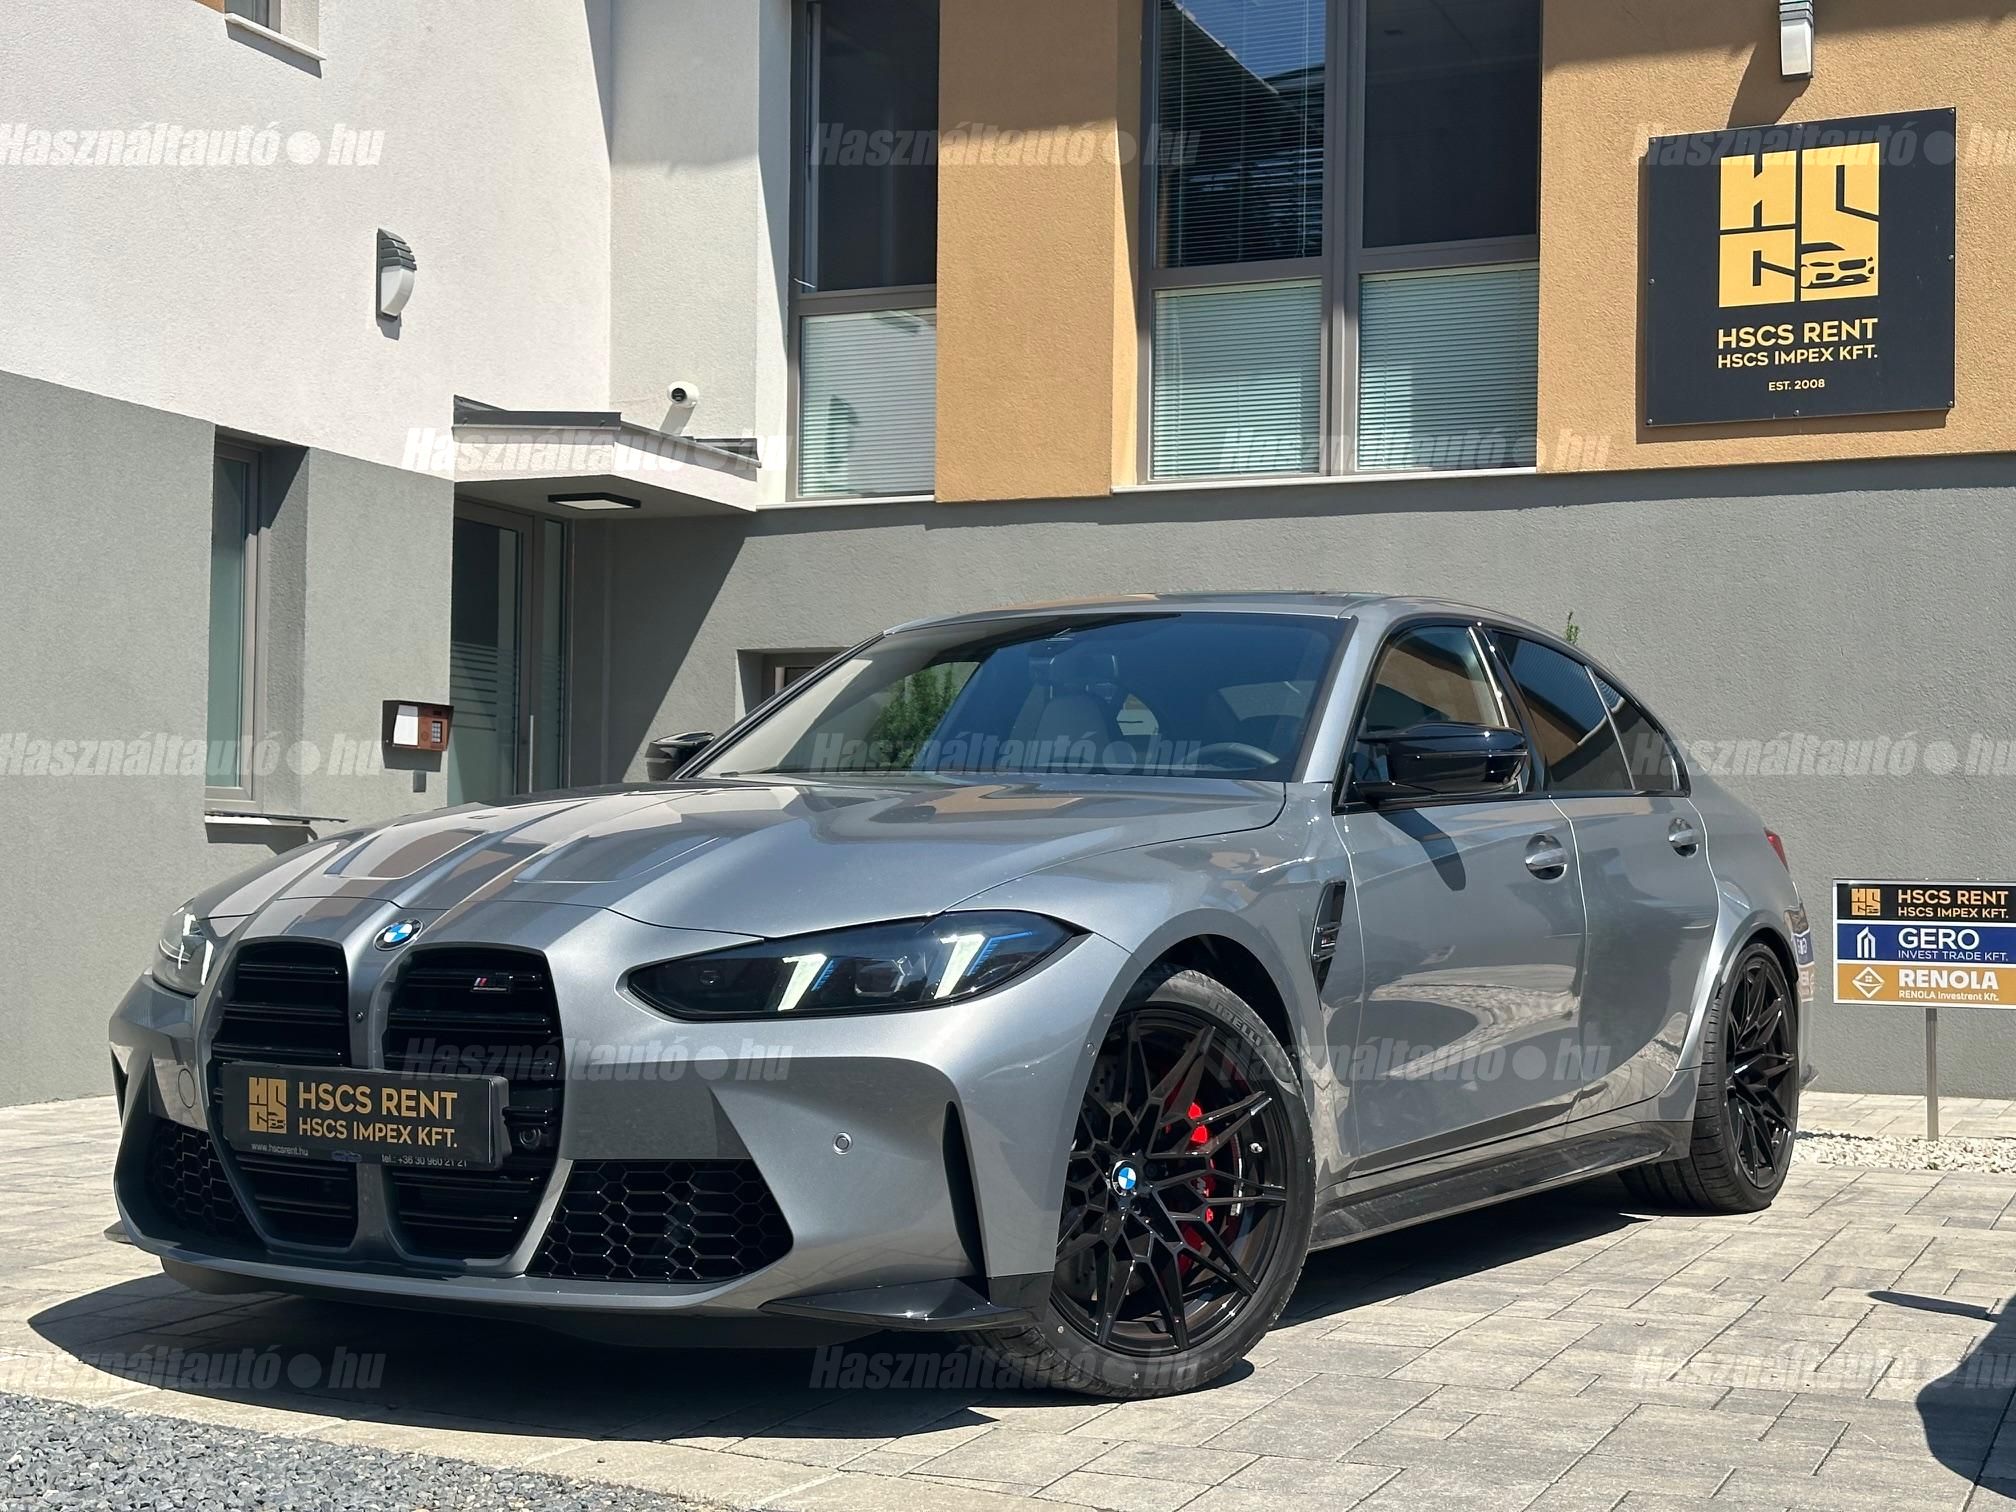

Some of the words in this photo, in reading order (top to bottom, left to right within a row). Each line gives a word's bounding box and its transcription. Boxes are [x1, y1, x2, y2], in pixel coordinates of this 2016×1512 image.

[1718, 324, 1795, 349] HSCS
[1803, 317, 1878, 344] RENT
[1718, 351, 1769, 369] HSCS
[1774, 347, 1834, 366] IMPEX
[1839, 344, 1878, 362] KFT.
[1768, 381, 1792, 392] EST.
[1794, 378, 1825, 390] 2008
[1898, 889, 1951, 904] HSCS
[1957, 890, 2009, 906] RENT
[1898, 906, 1934, 917] HSCS
[1937, 907, 1978, 918] IMPEX
[1982, 908, 2009, 919] KFT.
[1898, 927, 1980, 950] GERO
[1898, 950, 1939, 960] INVEST
[1942, 951, 1981, 961] TRADE
[1984, 952, 2009, 962] KFT.
[1898, 969, 1999, 990] RENOLA
[1898, 990, 1936, 1000] RENOLA
[298, 1081, 372, 1114] HSCS
[381, 1087, 458, 1120] RENT
[298, 1117, 347, 1140] HSCS
[353, 1120, 413, 1146] IMPEX
[417, 1126, 458, 1148] KFT.
